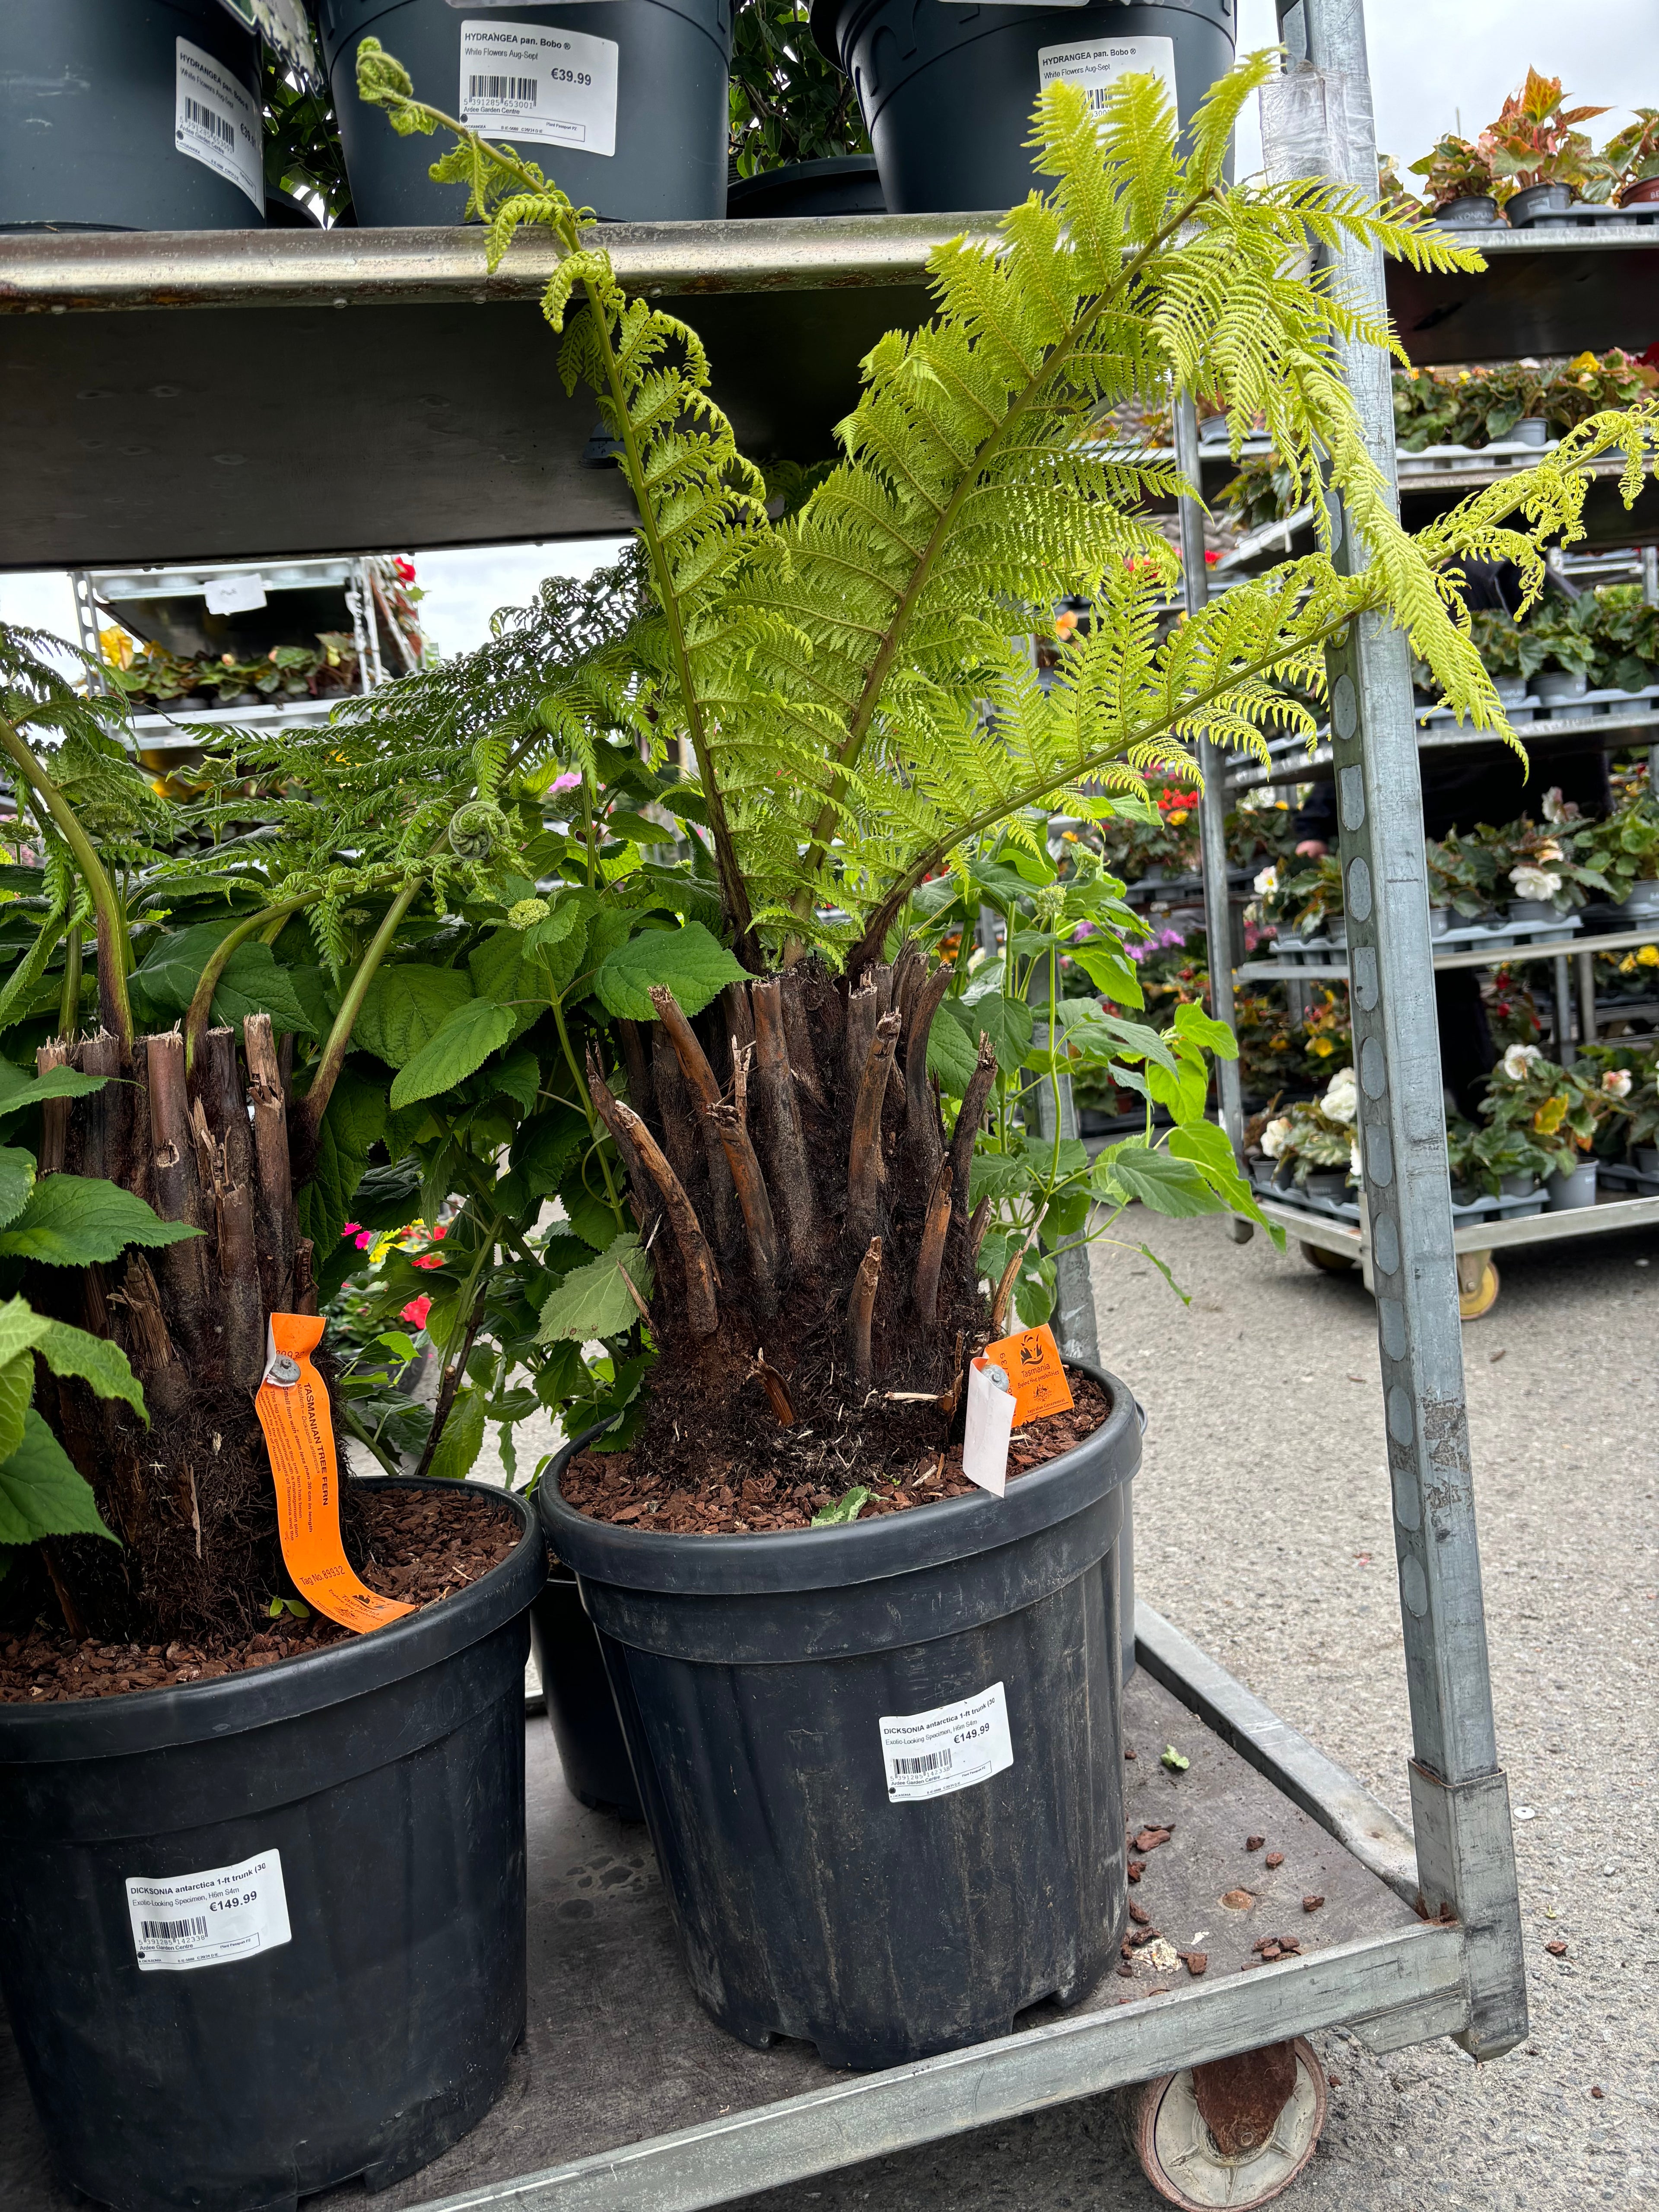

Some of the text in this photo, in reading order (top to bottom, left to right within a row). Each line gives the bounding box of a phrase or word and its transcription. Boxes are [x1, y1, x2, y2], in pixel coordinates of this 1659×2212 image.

[465, 33, 518, 43] HYDRANGEA
[540, 38, 562, 49] Bobo
[483, 48, 507, 57] Flowers
[509, 51, 538, 60] Aug-Sept
[1042, 52, 1091, 66] HYDRANGEA
[1093, 51, 1109, 60] pan.
[180, 52, 221, 86] HYDRANGEA
[180, 67, 196, 82] White
[551, 67, 591, 86] €39.99
[1044, 71, 1060, 79] White
[1062, 67, 1084, 76] Flowers
[472, 99, 500, 107] 391285
[504, 100, 533, 109] 653001
[1021, 1363, 1050, 1378] Tasmania
[297, 1384, 305, 1408] Manfern
[302, 1416, 312, 1444] Dicksonia
[310, 1445, 321, 1474] antarctica
[304, 1382, 322, 1444] TASMANIAN
[317, 1445, 327, 1474] TREE
[283, 1387, 291, 1405] Small
[308, 1491, 312, 1501] cm
[299, 1576, 314, 1586] Tag
[342, 1594, 380, 1616] Tasmania
[884, 1725, 925, 1734] DICKSONIA
[926, 1715, 958, 1729] antarctica
[960, 1710, 971, 1719] 1-ft
[972, 1703, 987, 1714] trunk
[886, 1736, 925, 1745] Exotic-Looking
[926, 1729, 952, 1740] Specimen,
[953, 1723, 990, 1744] €149.99
[927, 1766, 950, 1777] 142338
[175, 1881, 215, 1893] antarctica
[216, 1877, 231, 1886] 1-ft
[232, 1869, 253, 1882] trunk
[254, 1862, 266, 1874] (30
[133, 1887, 240, 1907] Exotic-Looking Specimen, H6m S4m
[209, 1891, 257, 1912] €149.99
[177, 1935, 205, 1945] 142338
